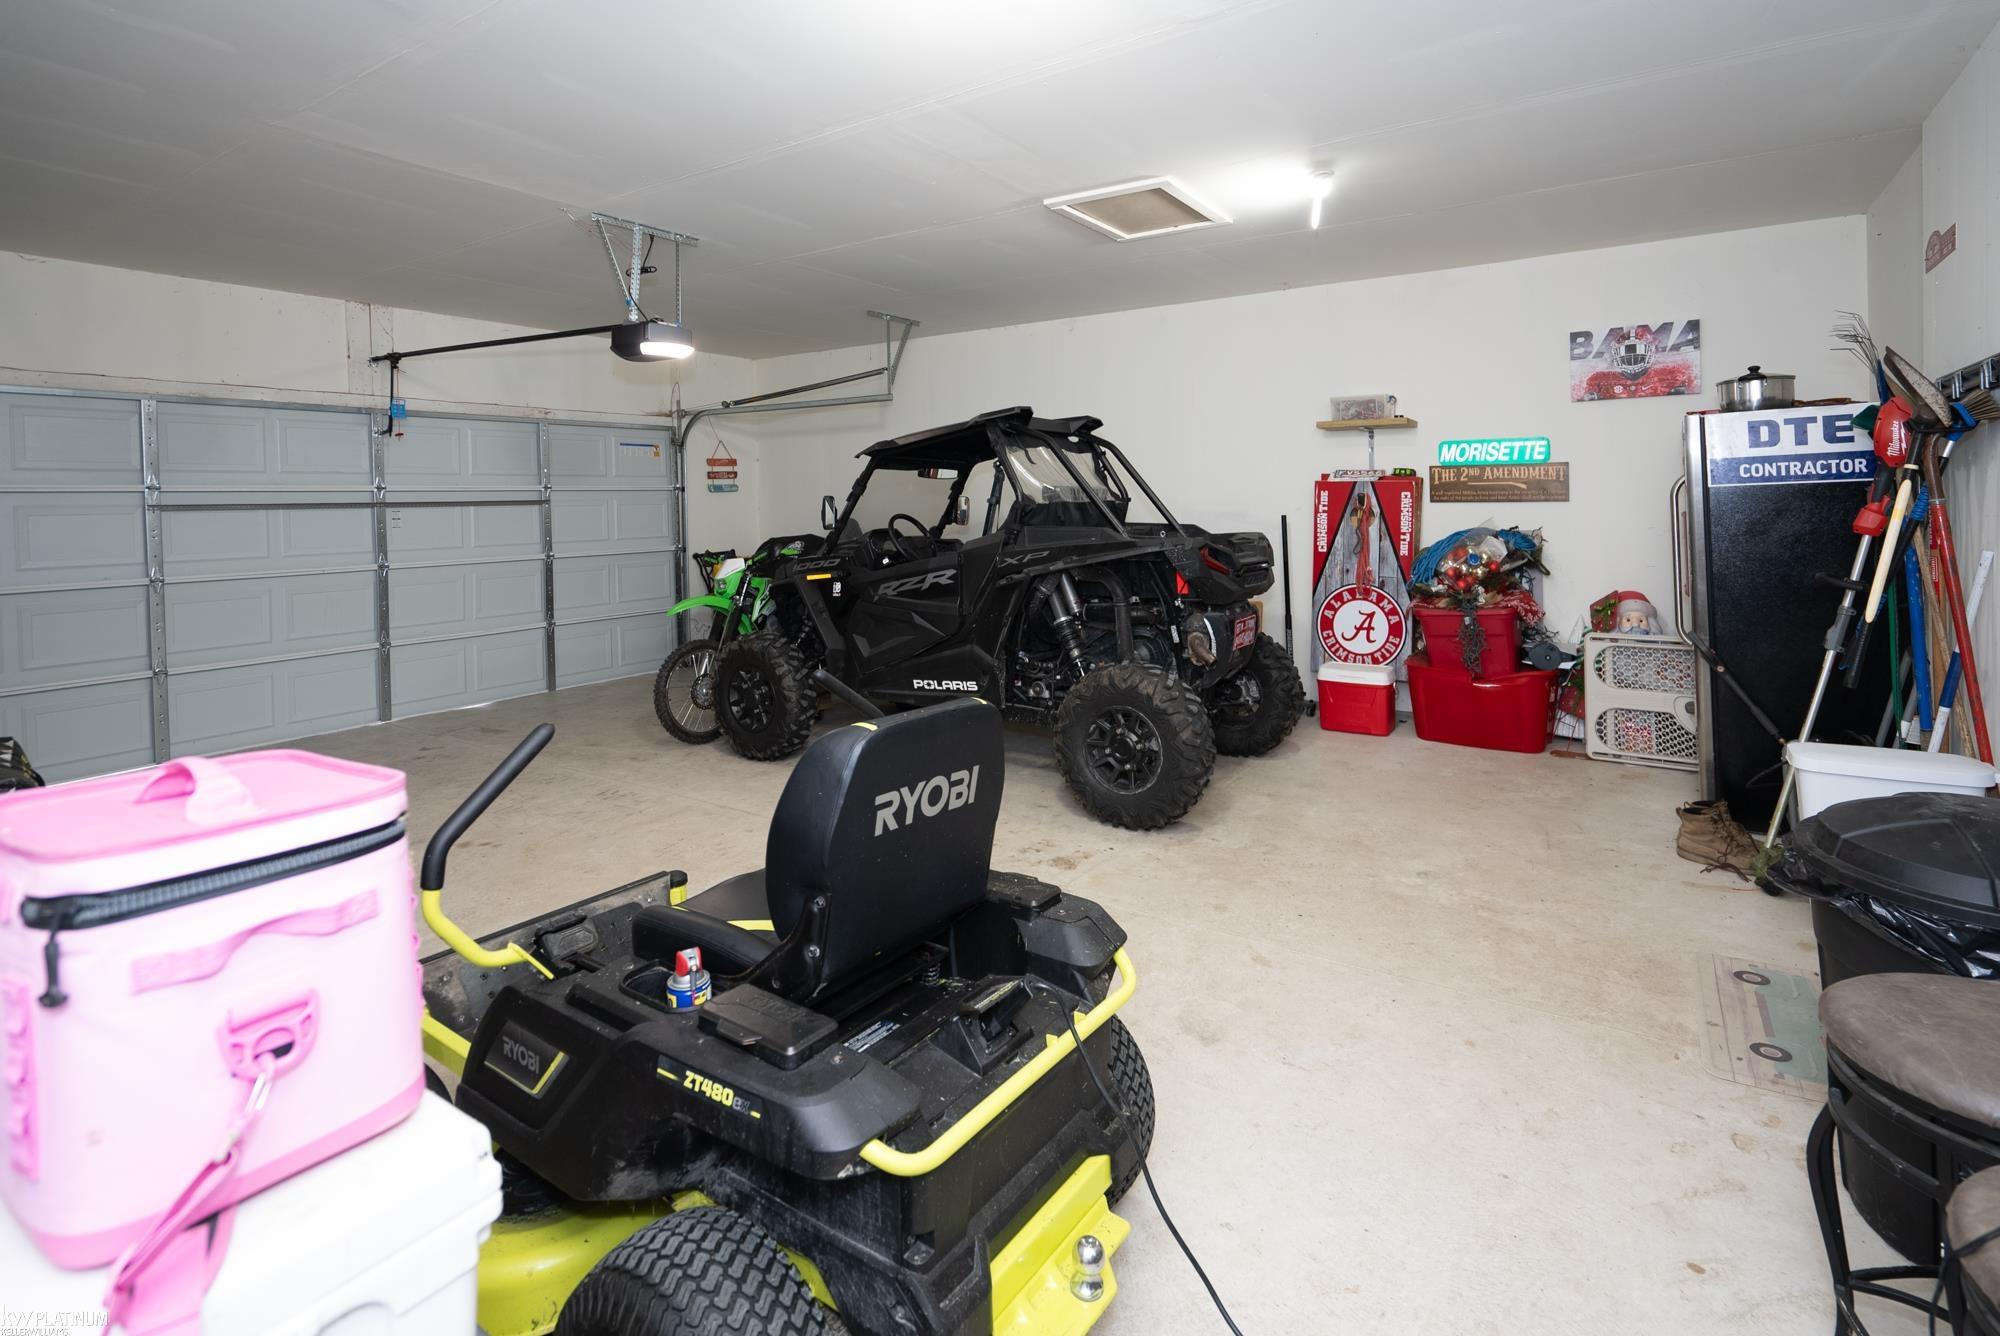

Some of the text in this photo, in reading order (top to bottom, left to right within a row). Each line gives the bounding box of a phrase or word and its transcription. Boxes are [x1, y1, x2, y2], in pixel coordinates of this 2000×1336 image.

[1747, 413, 1855, 449] DTE
[1887, 420, 1899, 457] Milwaukee
[1440, 440, 1548, 462] MORISETTE
[1431, 467, 1457, 484] THE
[1483, 465, 1567, 480] AMENDMENT
[1739, 458, 1867, 478] CONTRACTOR
[1319, 490, 1329, 512] TIDE
[1400, 533, 1410, 556] TIDE
[997, 550, 1050, 568] XP
[874, 569, 957, 602] RZR
[1341, 610, 1377, 643] A
[1322, 629, 1373, 665] CRIMSON
[1373, 635, 1400, 662] TIDE
[913, 679, 978, 691] POLARIS
[874, 765, 980, 837] RYOBI
[502, 1036, 540, 1074] RYOBI
